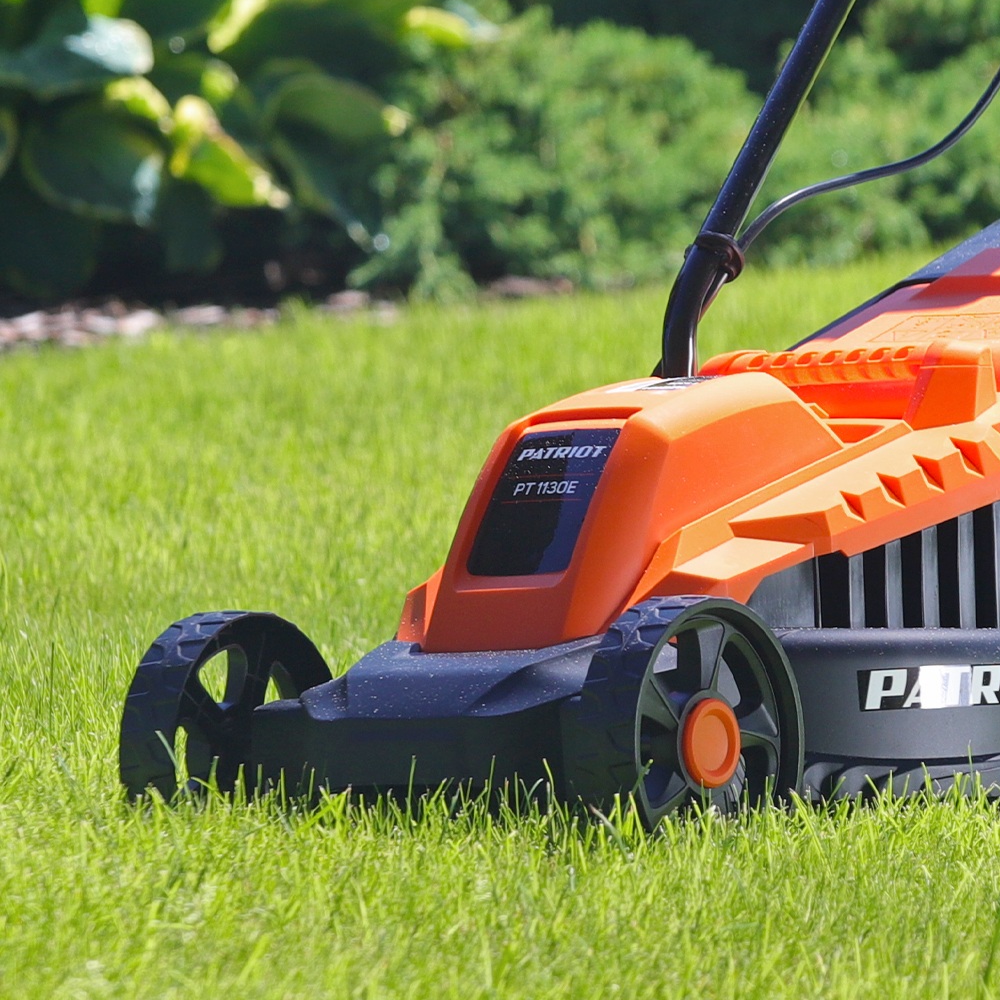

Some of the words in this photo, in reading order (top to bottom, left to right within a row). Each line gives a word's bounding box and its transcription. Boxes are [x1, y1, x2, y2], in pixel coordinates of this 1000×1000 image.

[517, 445, 607, 461] PATRIOT
[513, 482, 535, 496] PT
[536, 480, 579, 495] 1130E
